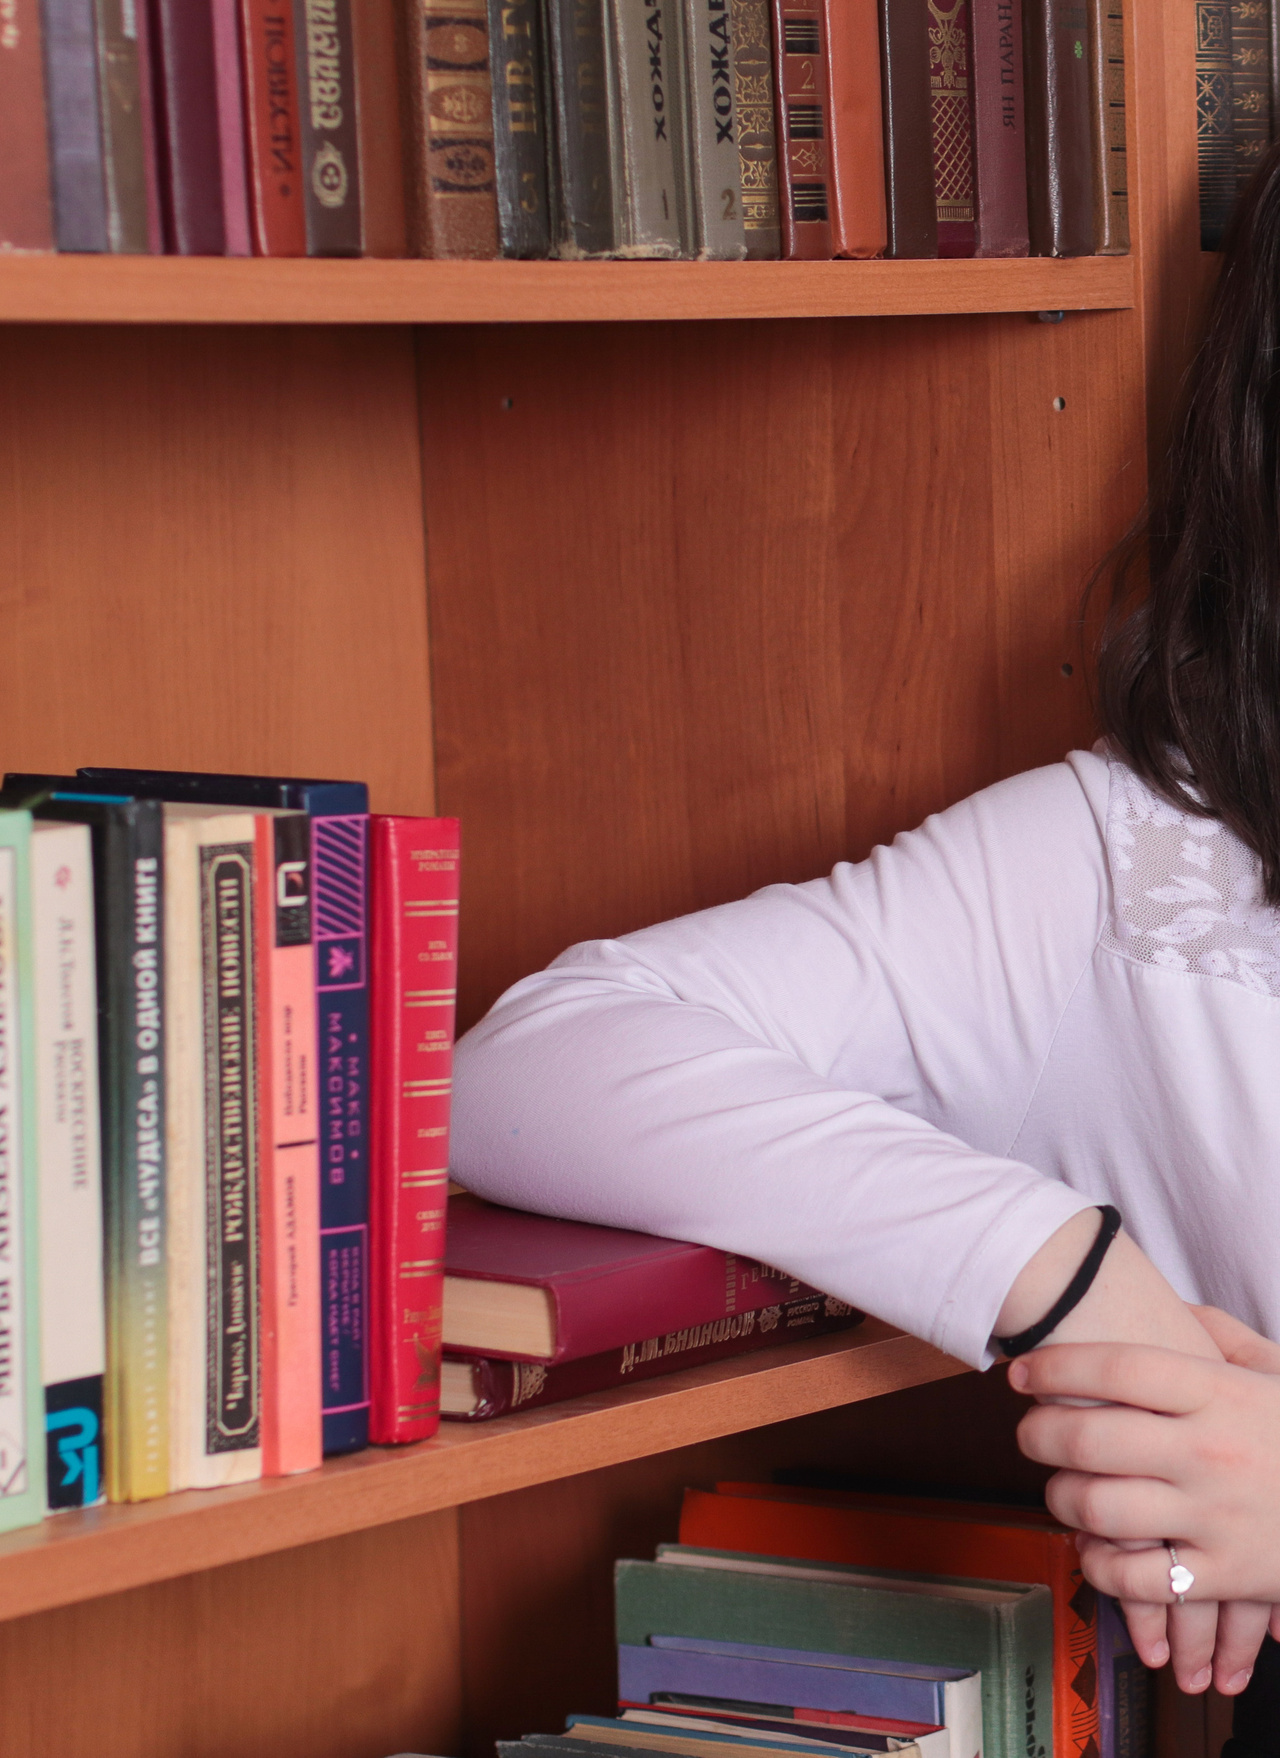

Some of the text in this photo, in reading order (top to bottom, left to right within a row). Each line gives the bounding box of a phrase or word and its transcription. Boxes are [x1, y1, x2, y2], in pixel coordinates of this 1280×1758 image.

[801, 61, 815, 89] 2
[997, 0, 1016, 129] ЯН ПАРАН
[721, 188, 737, 220] 2
[136, 857, 158, 943] КНИГЕ
[131, 950, 161, 1050] ОДНОЙ
[53, 1040, 69, 1124] Рассказы
[138, 1057, 159, 1075] В
[219, 877, 245, 1243] РОЖДЕСТВЕНСКИЕ ПОВЕСТИ
[298, 1053, 308, 1114] Рассказы
[327, 1012, 346, 1186] МАКСИМОВ
[347, 1056, 362, 1138] МАКС
[70, 1038, 89, 1190] ВОСКРЕСЕНИЕ
[136, 1081, 160, 1211] «ЧУДЕСА»
[138, 1215, 161, 1266] ВСЕ
[285, 1175, 299, 1307] Григорий АДАМОВ
[328, 1249, 339, 1301] КОГДА
[328, 1350, 340, 1391] СНЕГ
